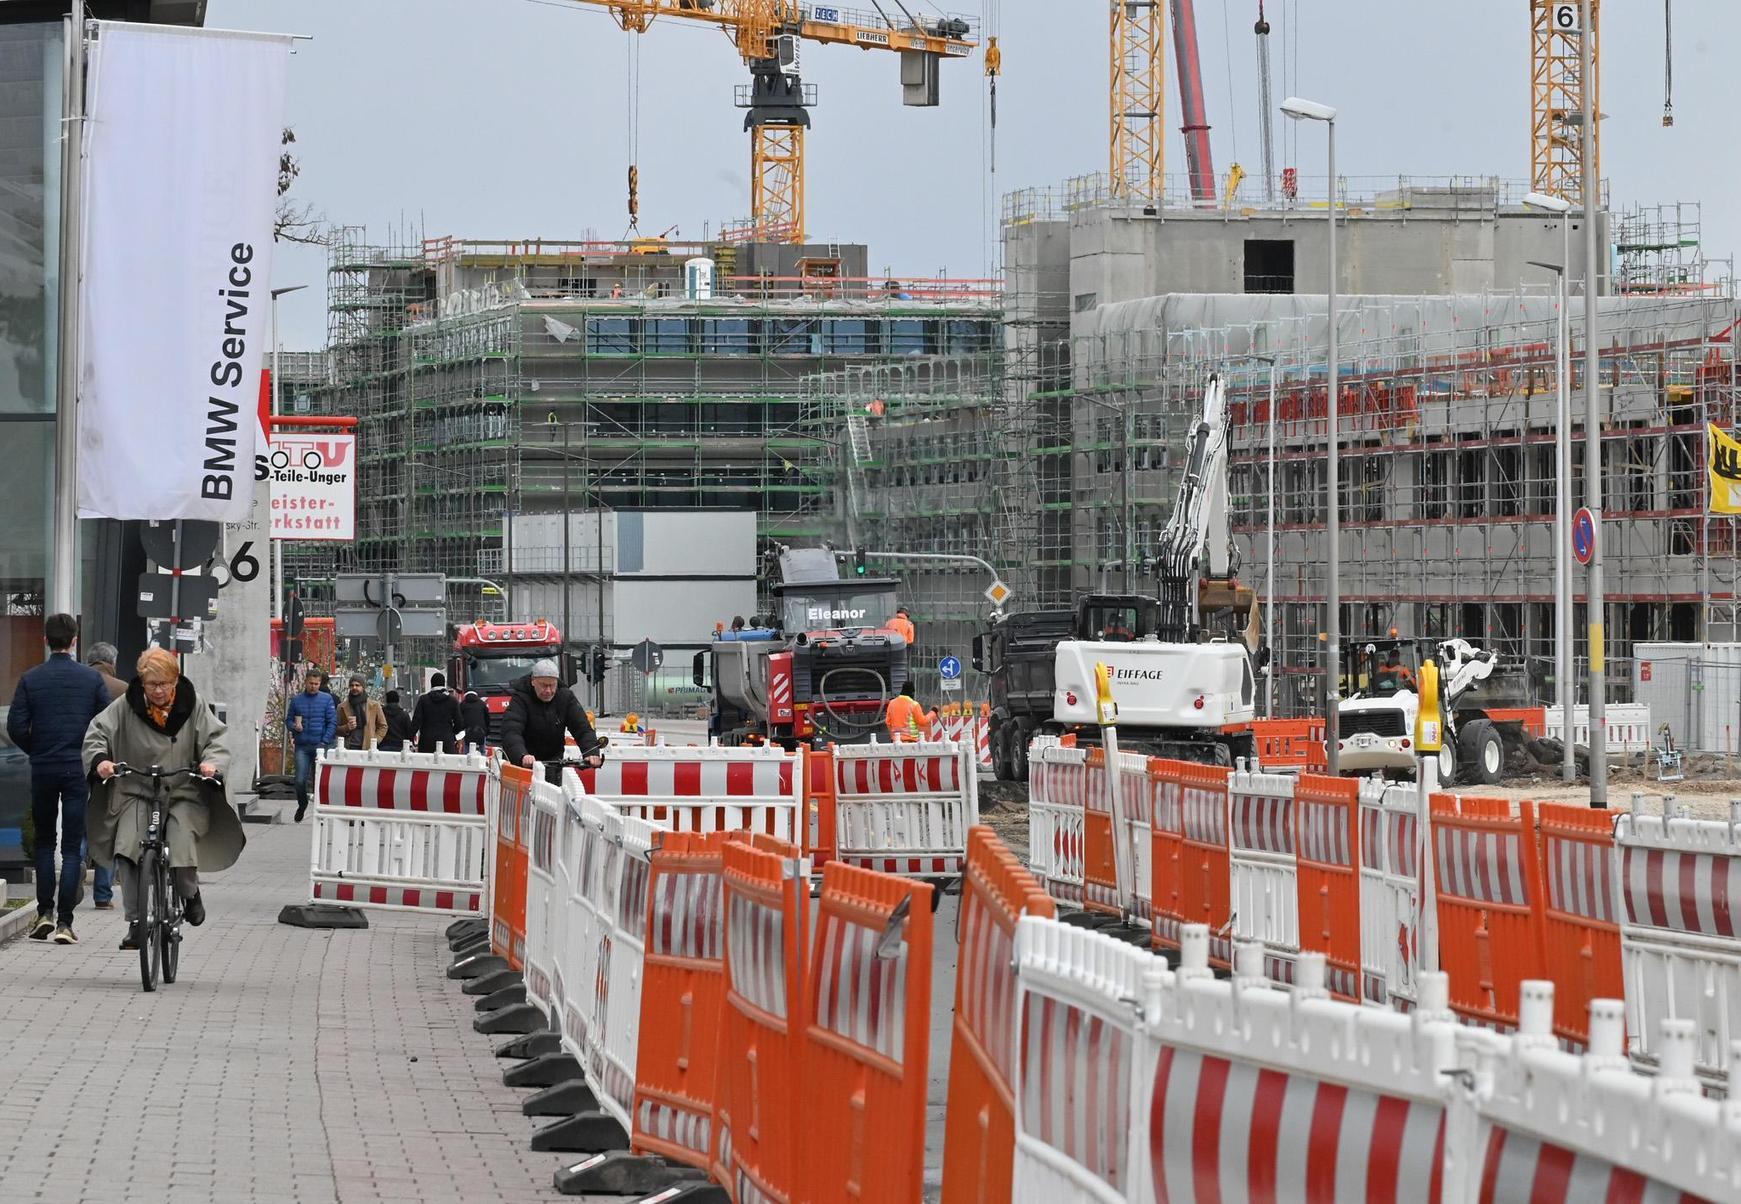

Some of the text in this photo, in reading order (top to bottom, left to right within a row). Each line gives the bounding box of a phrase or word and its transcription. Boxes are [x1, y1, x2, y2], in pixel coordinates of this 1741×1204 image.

[815, 7, 838, 22] ZECH
[1557, 5, 1573, 28] 6
[856, 31, 888, 43] LIEBHERR
[210, 242, 254, 388] Service
[201, 396, 240, 501] BMW
[270, 513, 341, 530] rkstatt
[808, 608, 866, 620] Eleanor
[1117, 669, 1163, 680] EIFFAGE
